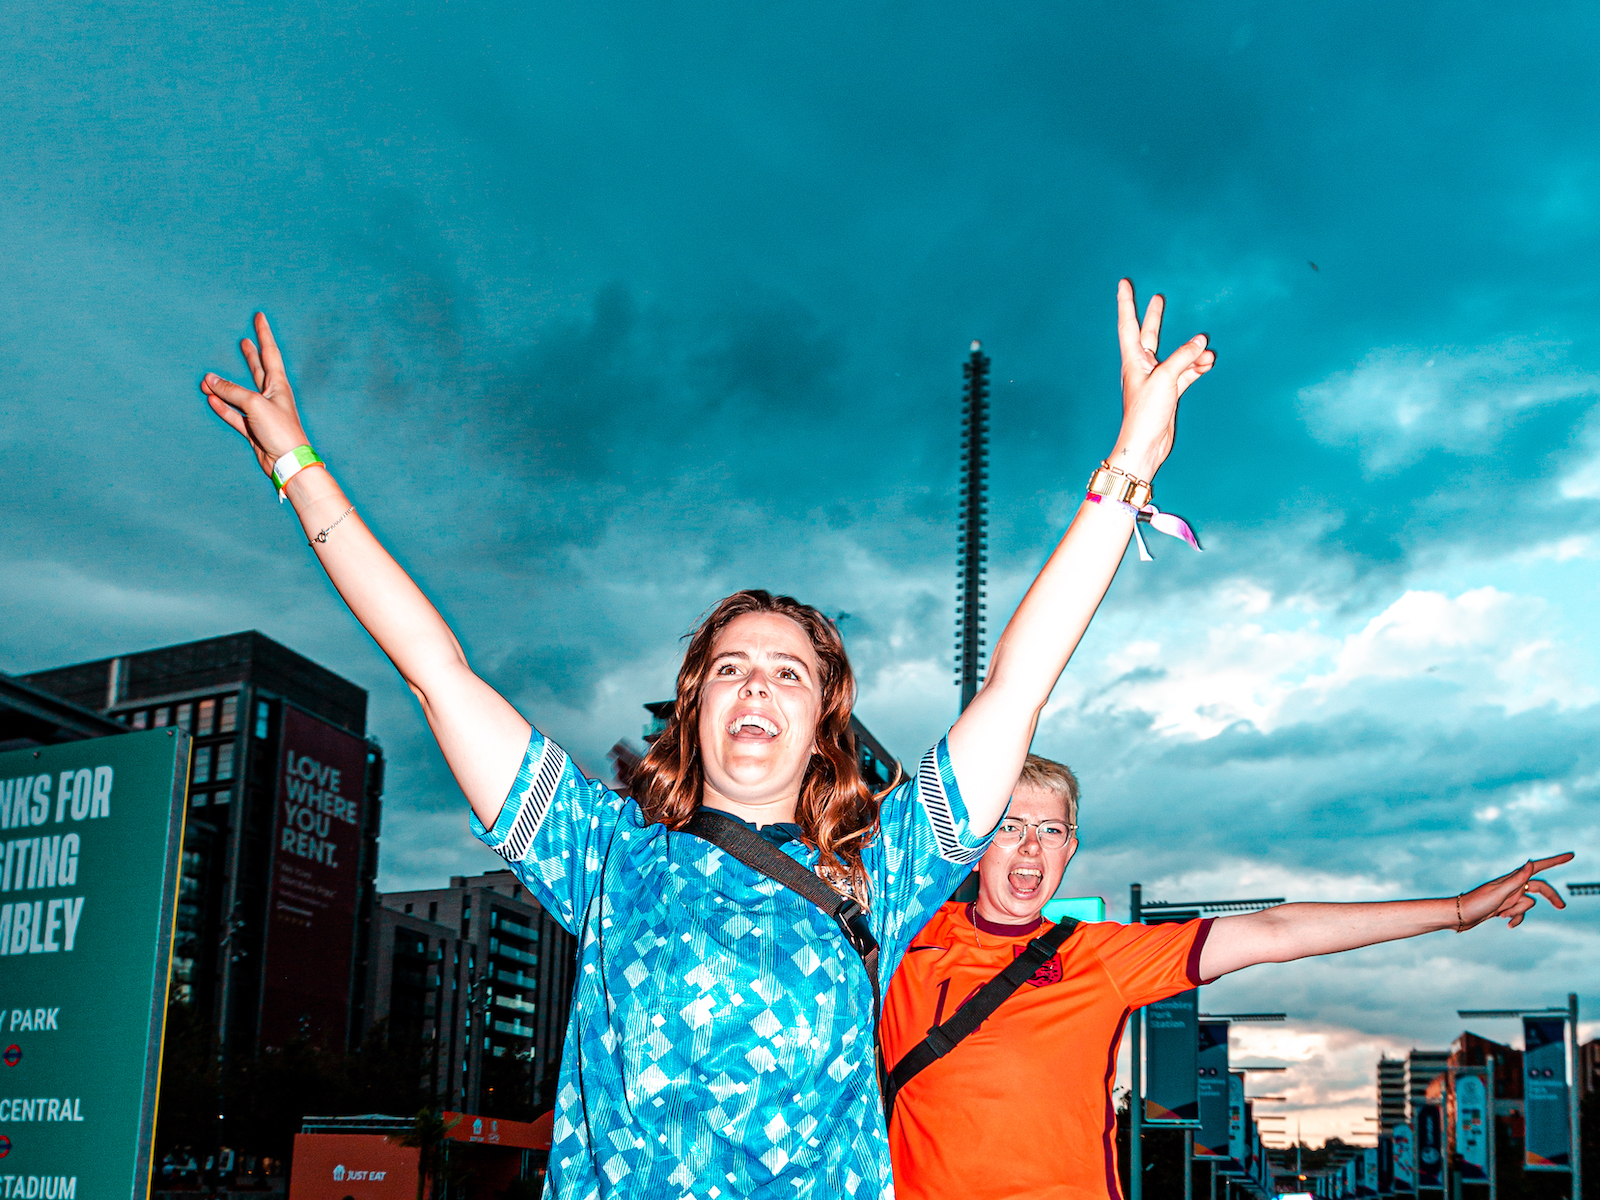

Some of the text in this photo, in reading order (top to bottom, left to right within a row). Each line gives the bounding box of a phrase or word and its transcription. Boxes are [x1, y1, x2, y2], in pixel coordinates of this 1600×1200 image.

[286, 750, 342, 793] LOVE
[55, 765, 113, 823] FOR
[285, 774, 358, 826] WHERE
[284, 801, 331, 839] YOU
[0, 833, 80, 892] ITING
[281, 826, 339, 869] RENT.
[9, 1007, 60, 1032] PARK
[0, 1098, 84, 1122] CENTRAL
[0, 1175, 77, 1200] TADIUM
[346, 1170, 387, 1182] JUST EAT
